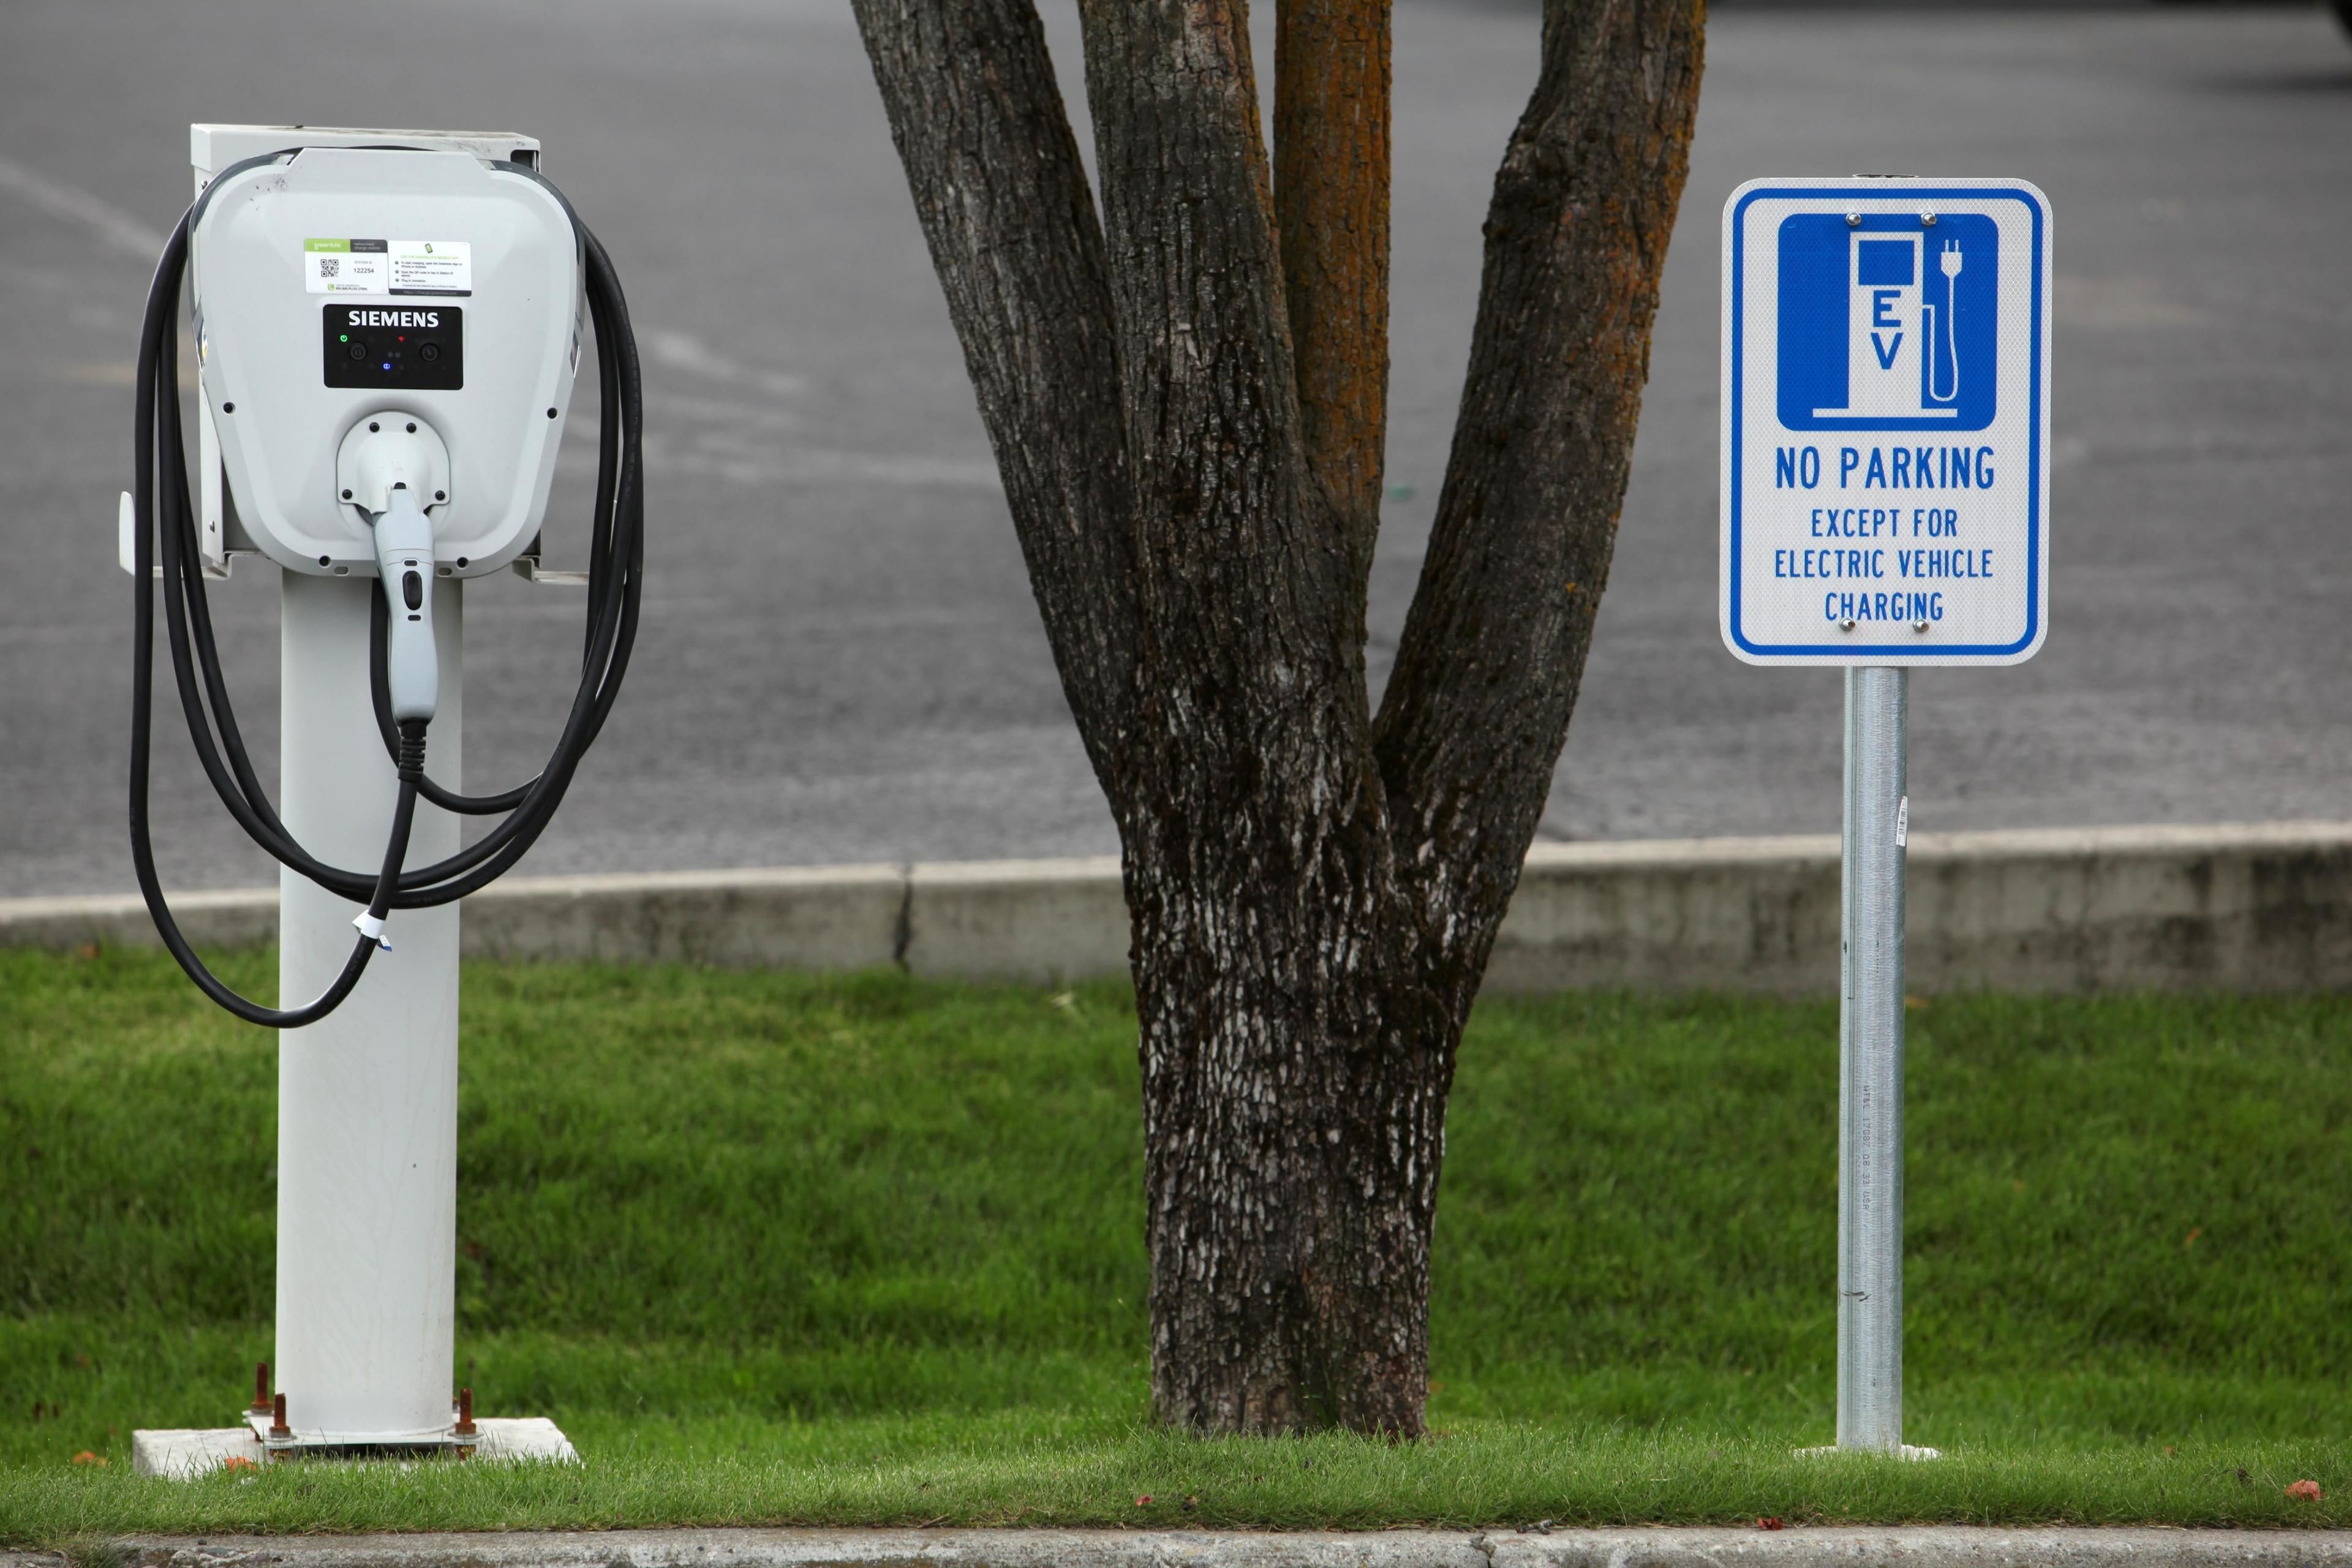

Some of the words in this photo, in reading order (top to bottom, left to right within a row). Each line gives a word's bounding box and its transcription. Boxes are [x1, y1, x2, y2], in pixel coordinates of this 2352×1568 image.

[349, 311, 439, 327] SIEMENS
[1776, 446, 1820, 489] NO
[1840, 446, 1994, 489] PARKING
[1811, 508, 1900, 538] EXCEPT
[1913, 508, 1958, 538] FOR
[1775, 549, 1884, 578] ELECTRIC
[1898, 549, 1992, 578] VEHICLE
[1825, 592, 1943, 622] CHARGING
